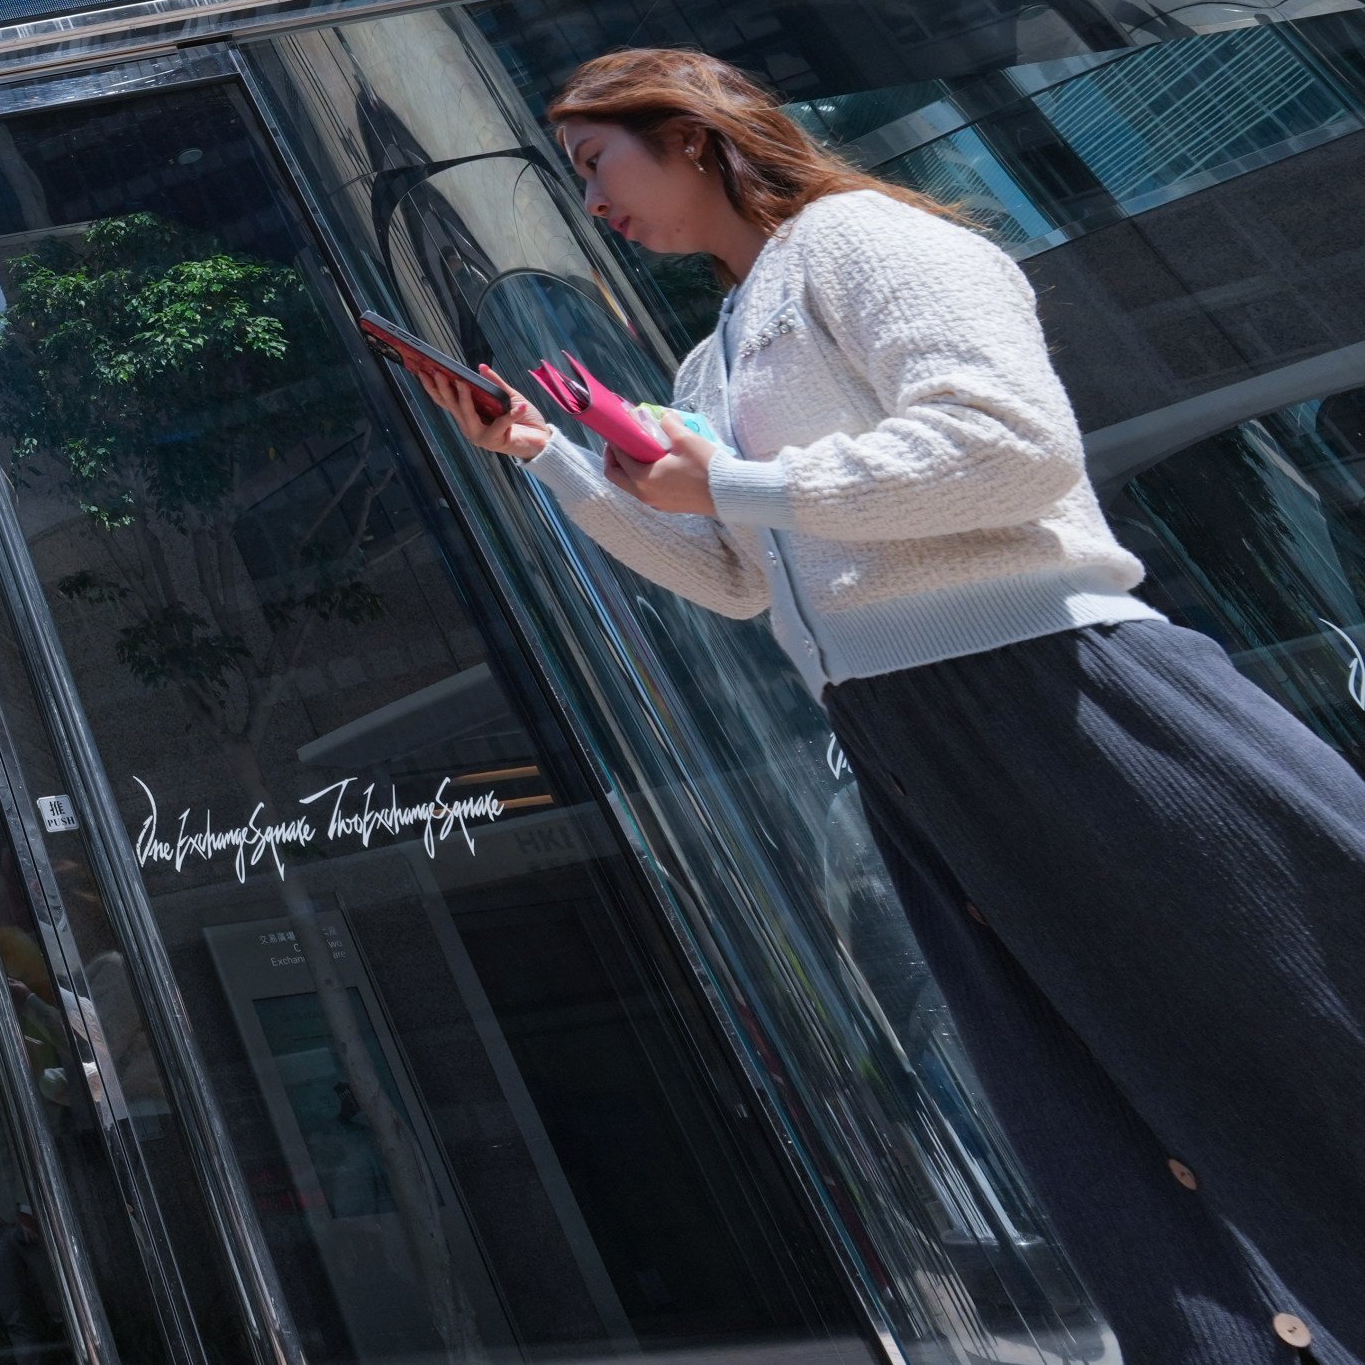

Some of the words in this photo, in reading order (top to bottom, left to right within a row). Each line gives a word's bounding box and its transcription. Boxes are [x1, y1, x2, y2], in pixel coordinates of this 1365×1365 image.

[50, 801, 66, 816] 推
[47, 816, 75, 827] PUSH
[270, 955, 307, 966] Exchan
